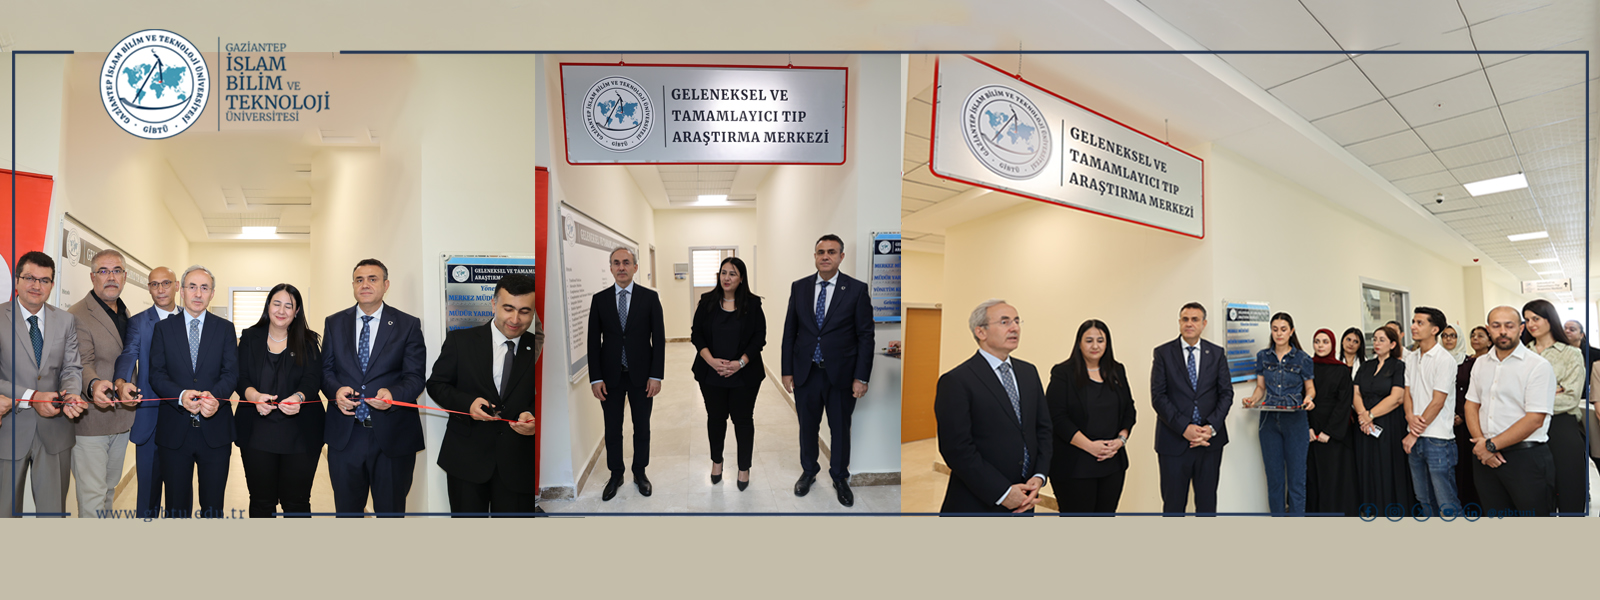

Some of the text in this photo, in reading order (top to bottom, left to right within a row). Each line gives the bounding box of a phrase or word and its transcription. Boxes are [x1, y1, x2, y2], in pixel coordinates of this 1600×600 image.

[671, 88, 789, 101] GELENEKSEL VE
[1004, 91, 1015, 100] VE
[671, 109, 807, 122] TAMAMLAYICI TIP
[672, 129, 829, 146] ARAŞTIRMA MERKEZİ
[1070, 126, 1167, 173] GELENEKSEL VE
[1069, 148, 1180, 195] TAMAMLAYICI TIP
[1069, 172, 1194, 218] ARAŞTIRMA MERKEZİ
[448, 309, 472, 317] MÜDÜR
